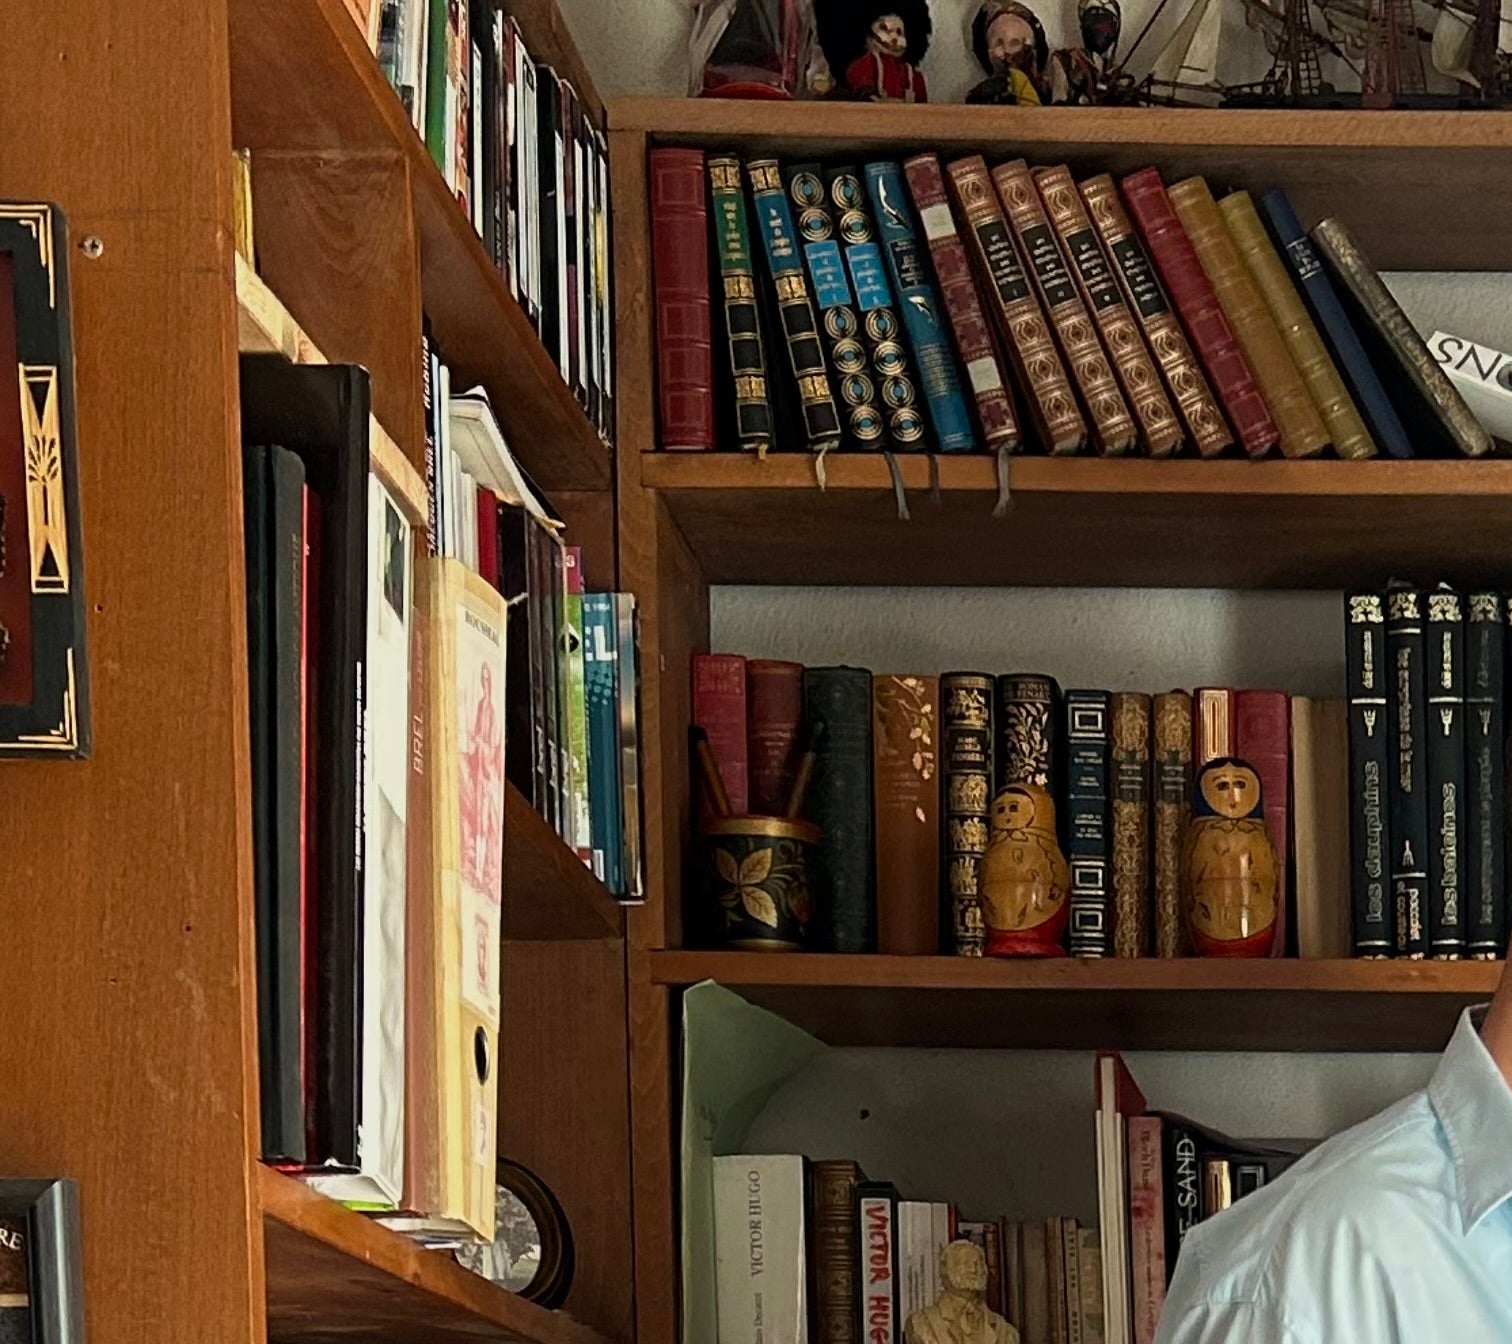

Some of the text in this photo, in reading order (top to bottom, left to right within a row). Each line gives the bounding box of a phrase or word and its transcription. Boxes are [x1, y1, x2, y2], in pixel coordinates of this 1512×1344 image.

[1177, 1137, 1196, 1211] SAND
[747, 1169, 763, 1277] VICTOR HUGO
[865, 1205, 890, 1284] VICTOR
